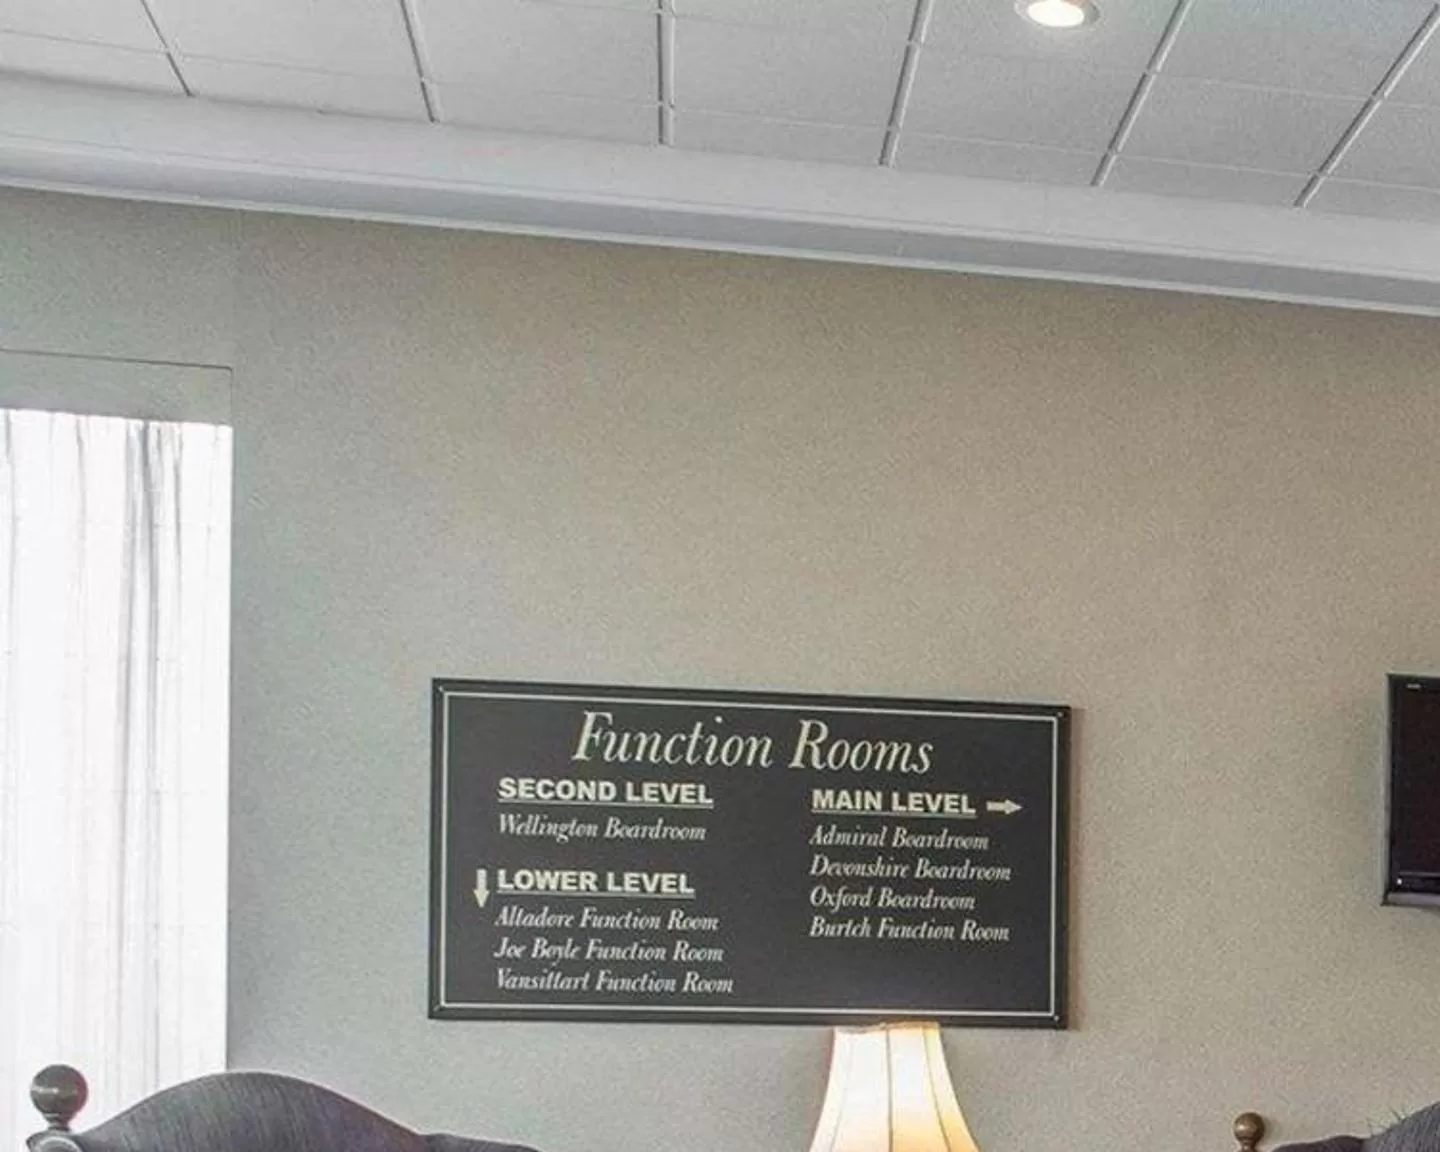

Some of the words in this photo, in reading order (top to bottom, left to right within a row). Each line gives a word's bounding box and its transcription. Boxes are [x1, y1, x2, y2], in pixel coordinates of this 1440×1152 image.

[571, 710, 773, 767] Function
[788, 719, 934, 775] Rooms
[498, 777, 617, 802] SECOND
[625, 781, 714, 806] LEVEL
[811, 789, 883, 811] MAIN
[891, 791, 977, 816] LEVEL
[499, 813, 599, 844] Wellington
[604, 816, 707, 841] Boardroom
[808, 824, 888, 848] Admiral
[892, 827, 990, 850] Boardroom
[809, 854, 911, 878] Devonshire
[914, 858, 1013, 881] Boardroom
[498, 869, 599, 893] LOWER
[606, 872, 696, 897] LEVEL
[809, 885, 873, 913] Oxford
[877, 887, 976, 910] Boardroom
[494, 906, 576, 929] Altadore
[579, 907, 662, 930] Function
[667, 909, 720, 931] Room
[809, 916, 871, 939] Burtch
[877, 918, 957, 941] Function
[960, 919, 1011, 942] Room
[493, 937, 527, 959] Joe
[531, 938, 579, 967] Boyle
[584, 938, 667, 962] Function
[672, 940, 725, 962] Room
[496, 967, 590, 991] Vansittart
[595, 969, 677, 993] Function
[682, 970, 735, 994] Room
